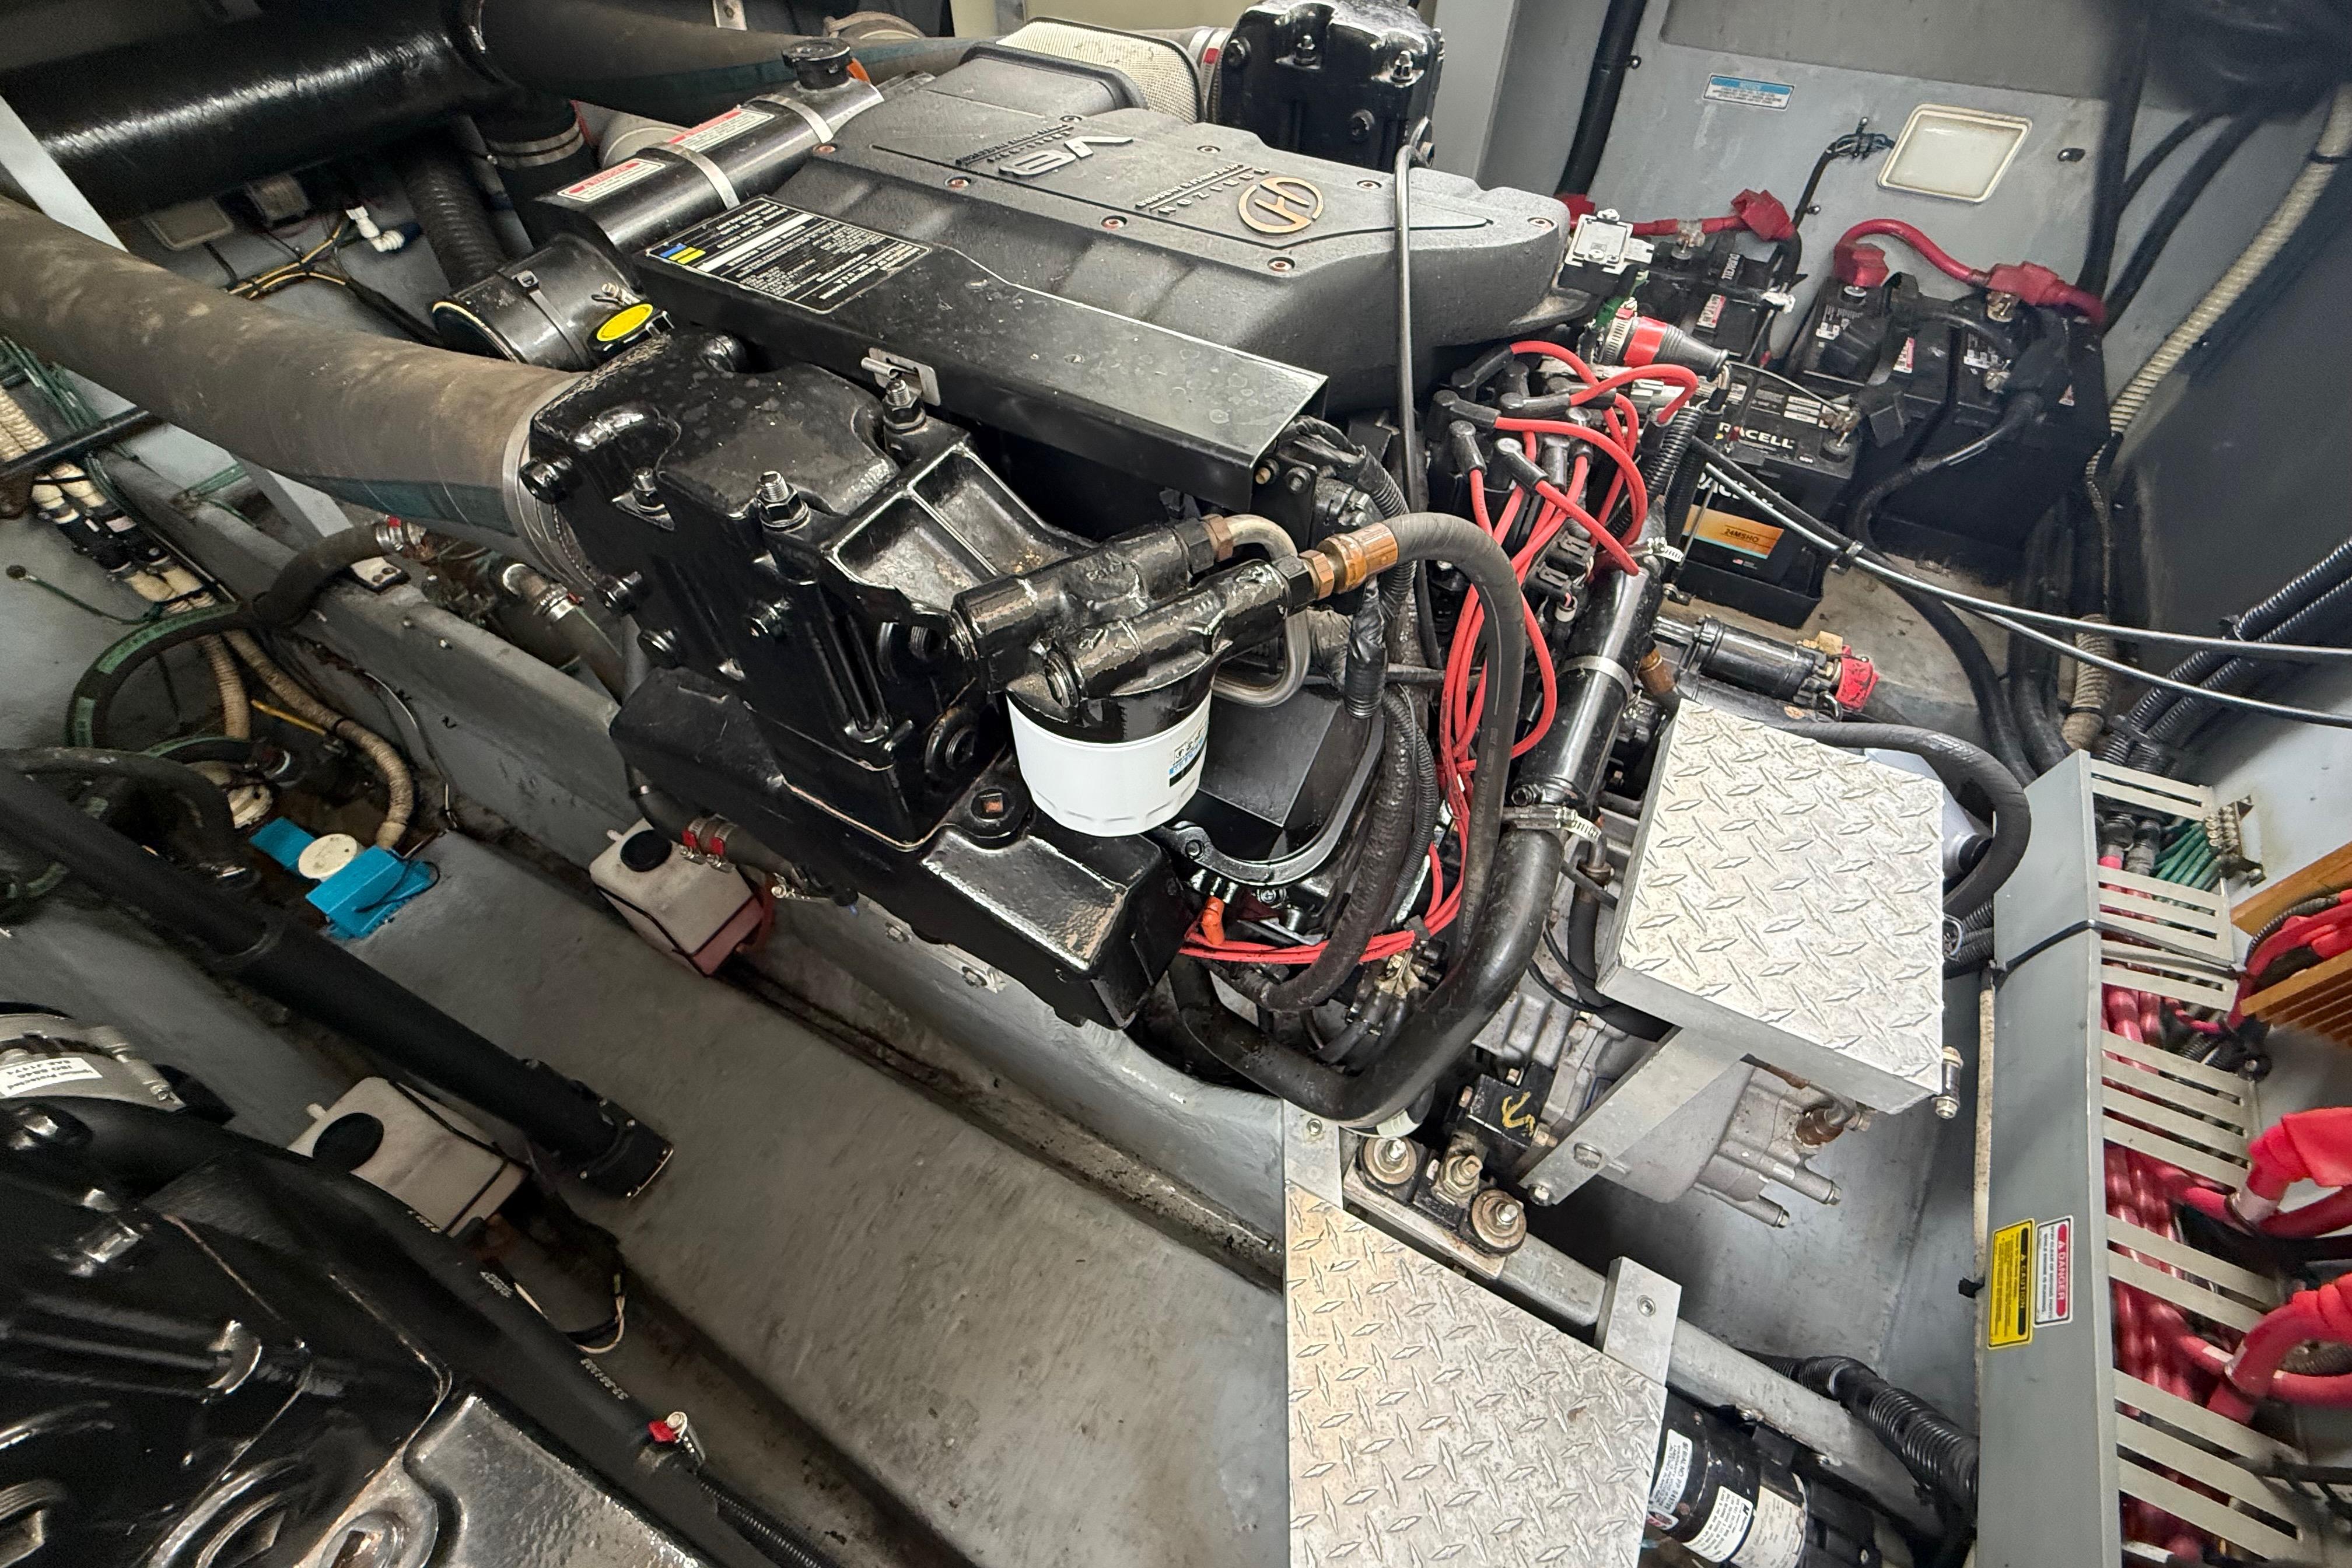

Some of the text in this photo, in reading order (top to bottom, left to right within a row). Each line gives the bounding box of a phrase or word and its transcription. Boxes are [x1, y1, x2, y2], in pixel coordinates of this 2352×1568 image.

[998, 136, 1133, 176] V8
[1157, 166, 1270, 215] HORIZON
[814, 252, 868, 282] SPECIFICATIONS
[1721, 253, 1741, 280] DURACELL
[2049, 1262, 2053, 1270] OF
[2057, 1251, 2066, 1301] DANGER
[1674, 1478, 1682, 1489] PP
